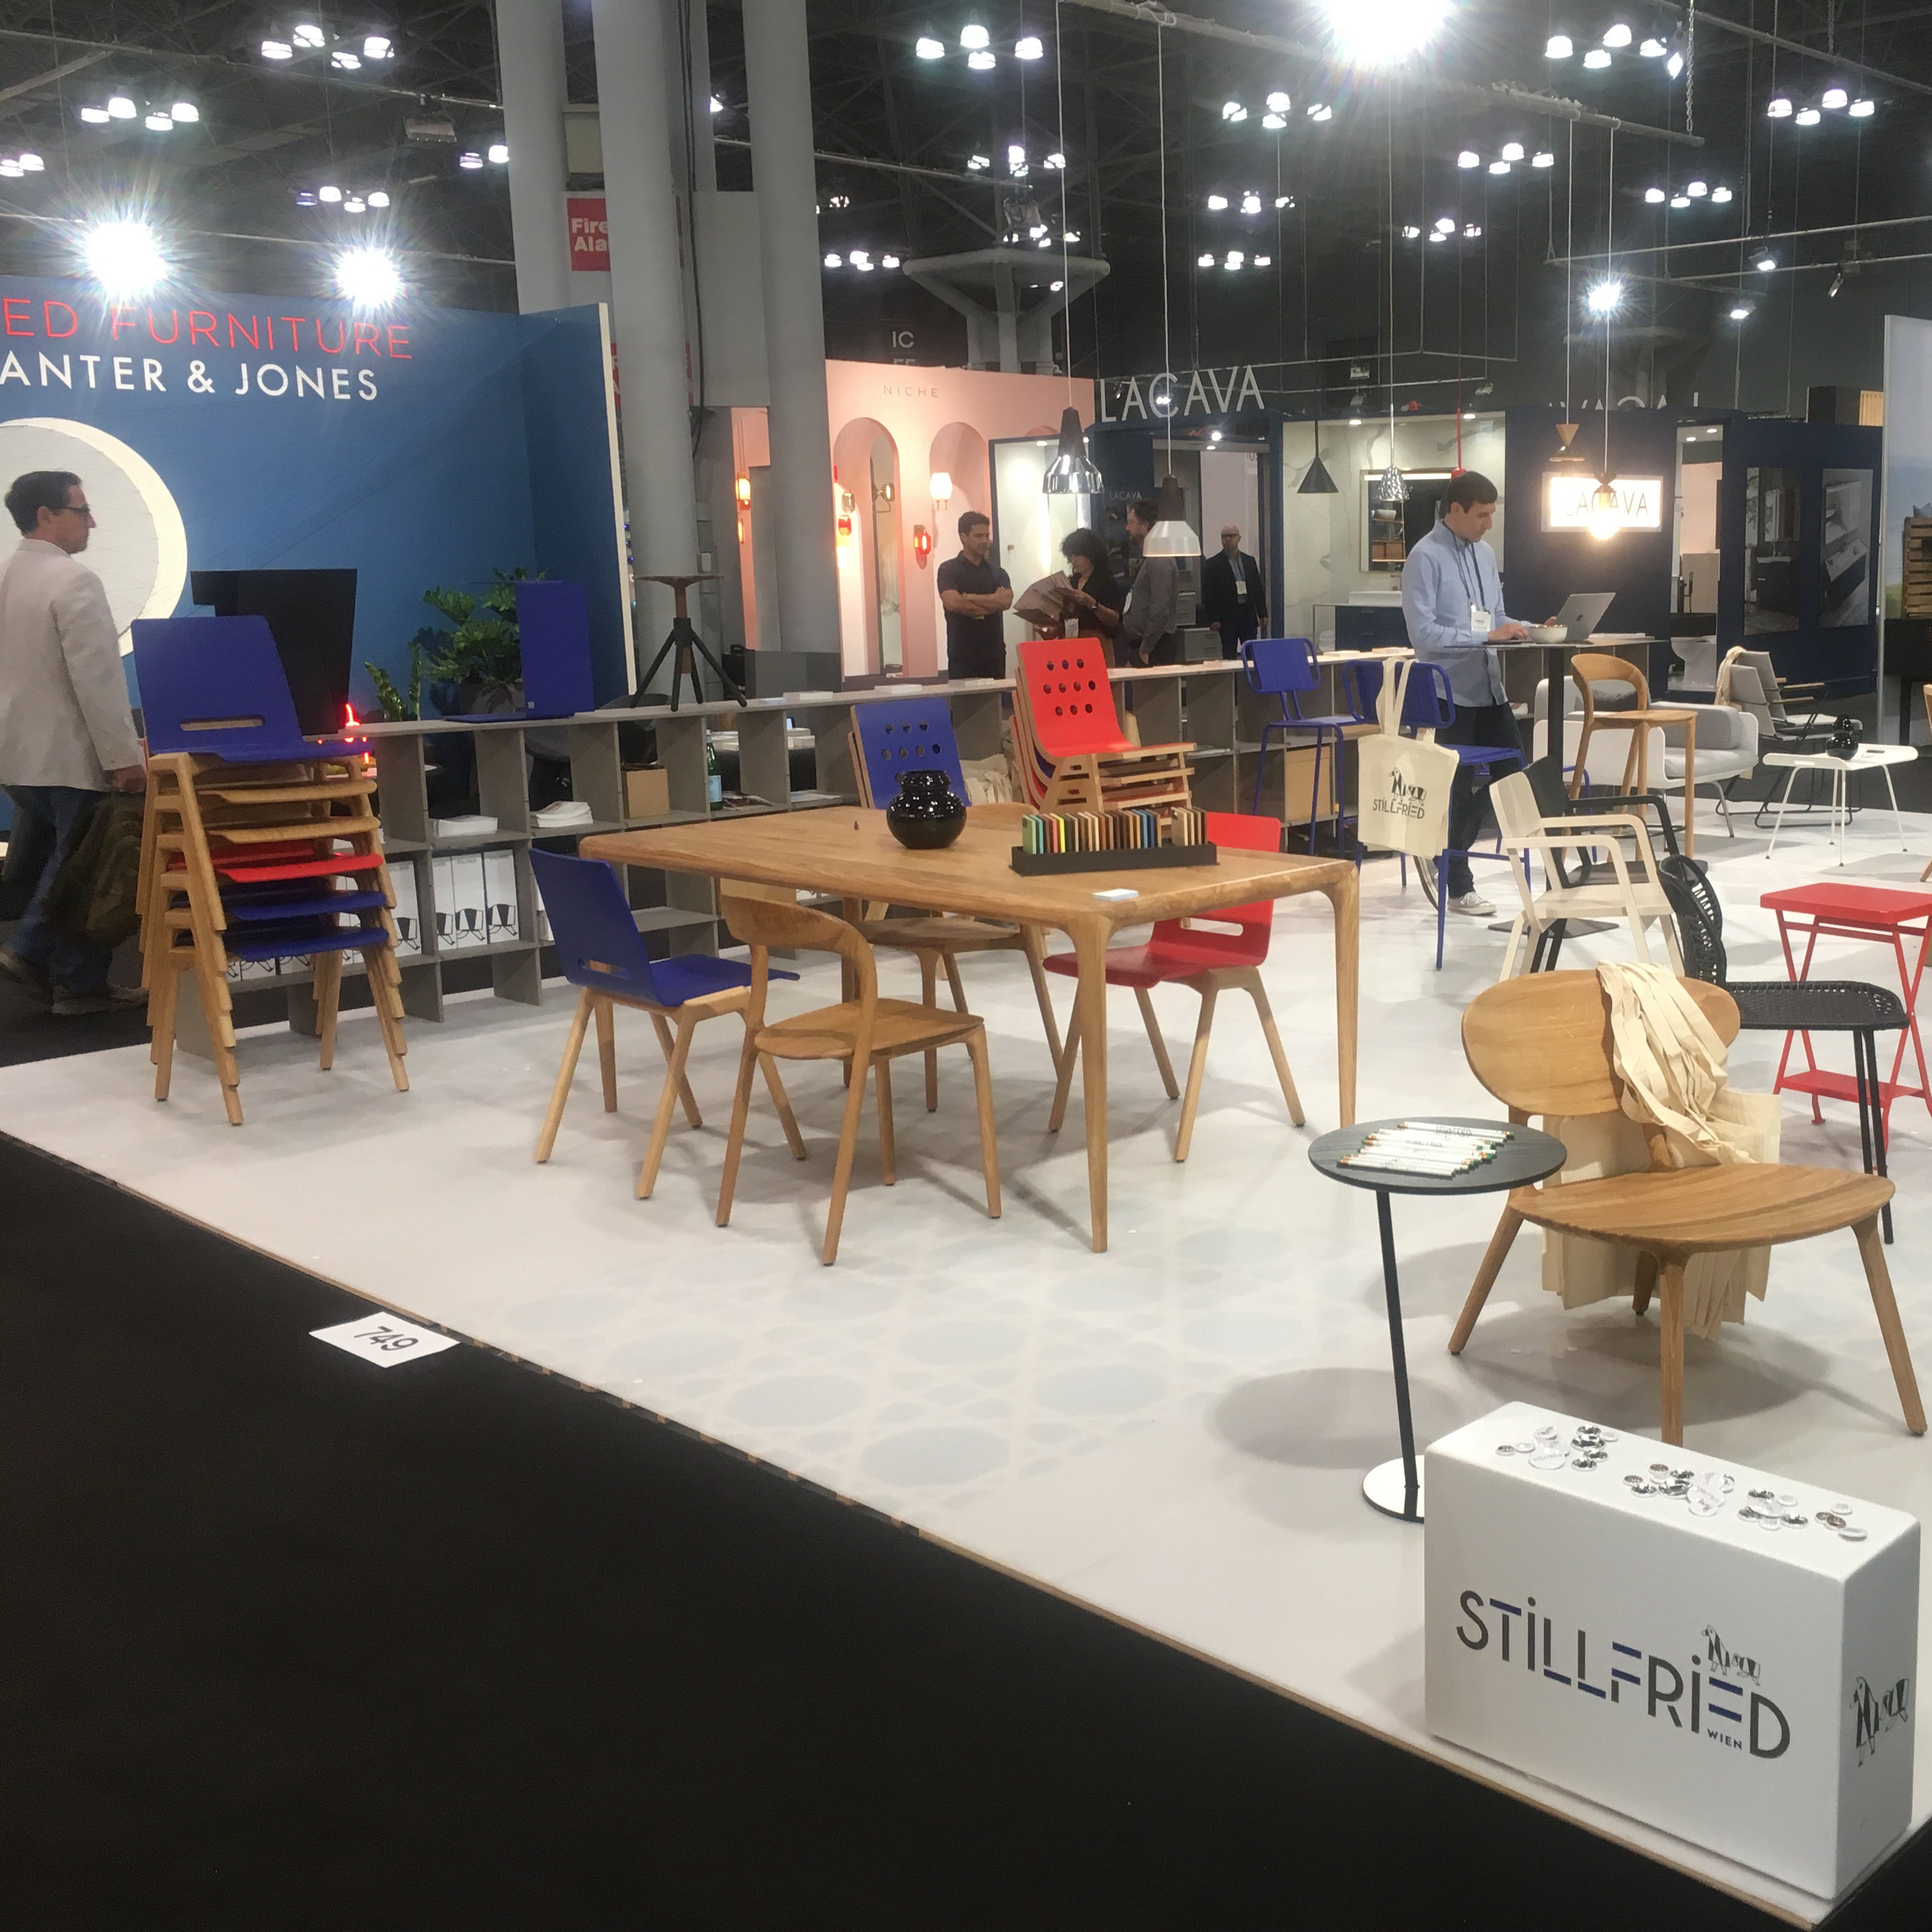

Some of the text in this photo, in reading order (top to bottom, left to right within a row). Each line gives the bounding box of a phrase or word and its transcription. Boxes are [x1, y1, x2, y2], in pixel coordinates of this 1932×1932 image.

[3, 297, 412, 360] ED FURNITURE
[892, 331, 914, 348] IC
[0, 349, 378, 401] ANTER & JONES
[883, 385, 939, 397] NICHE
[1100, 364, 1265, 423] LACAVA
[1108, 491, 1142, 501] LACAVA
[353, 1326, 419, 1351] 749
[1706, 1728, 1743, 1751] WIEN
